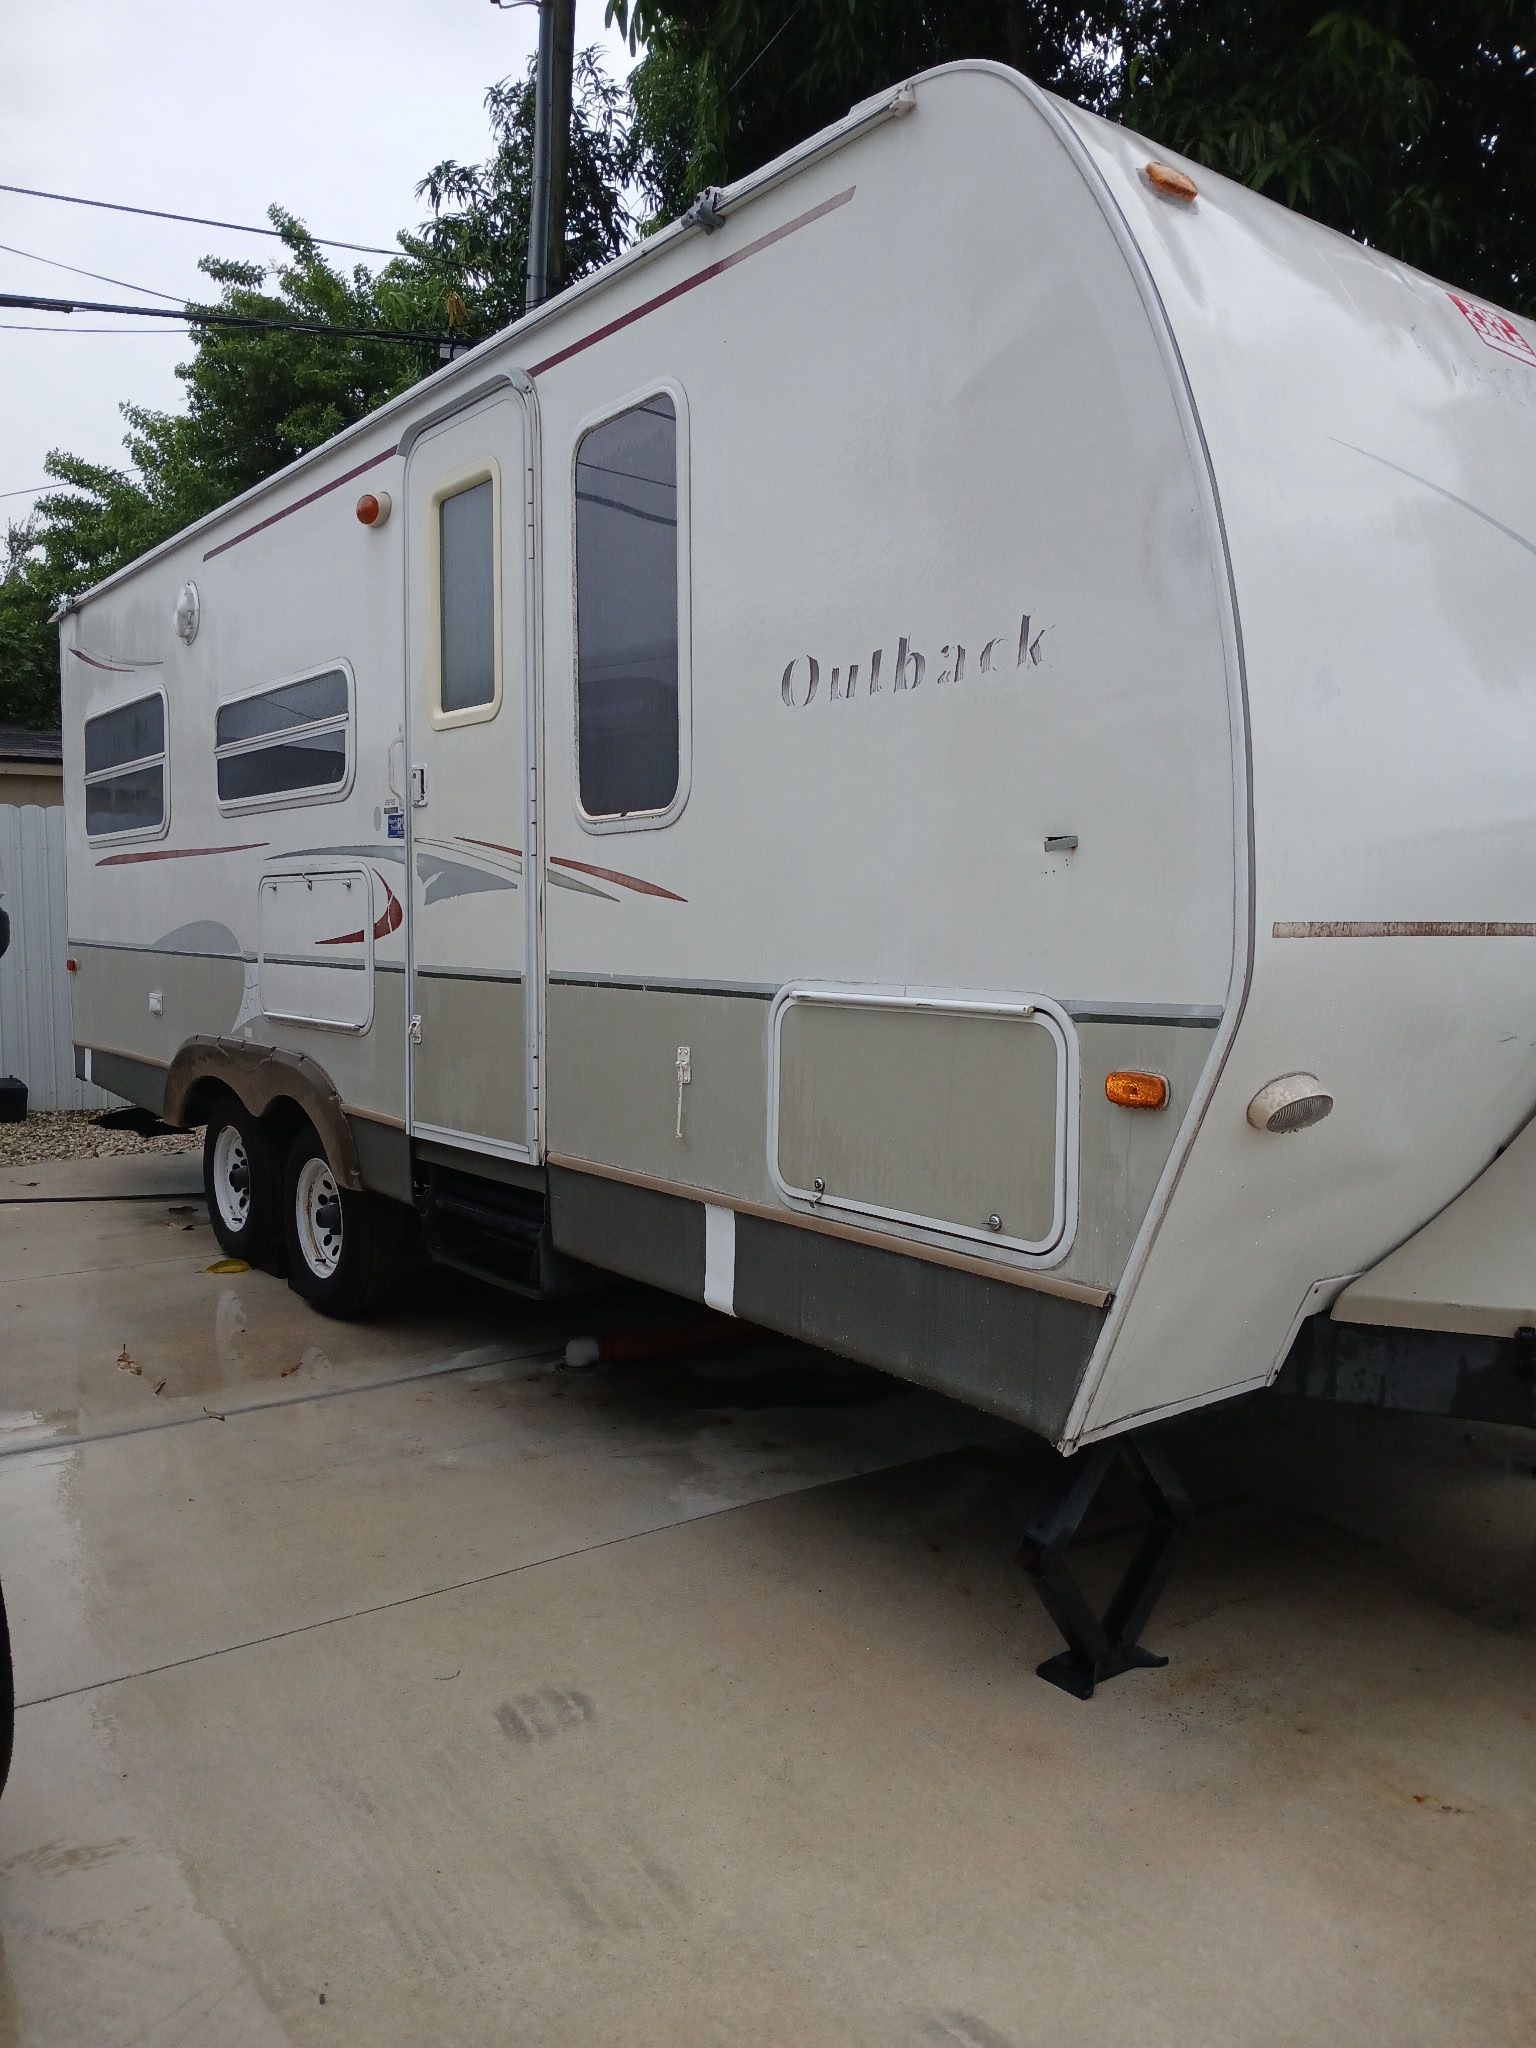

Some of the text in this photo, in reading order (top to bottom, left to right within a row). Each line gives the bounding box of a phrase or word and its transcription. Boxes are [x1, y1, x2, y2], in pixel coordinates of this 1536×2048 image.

[1458, 297, 1509, 331] FOR
[1465, 312, 1533, 353] SALE
[781, 613, 1054, 708] Outback
